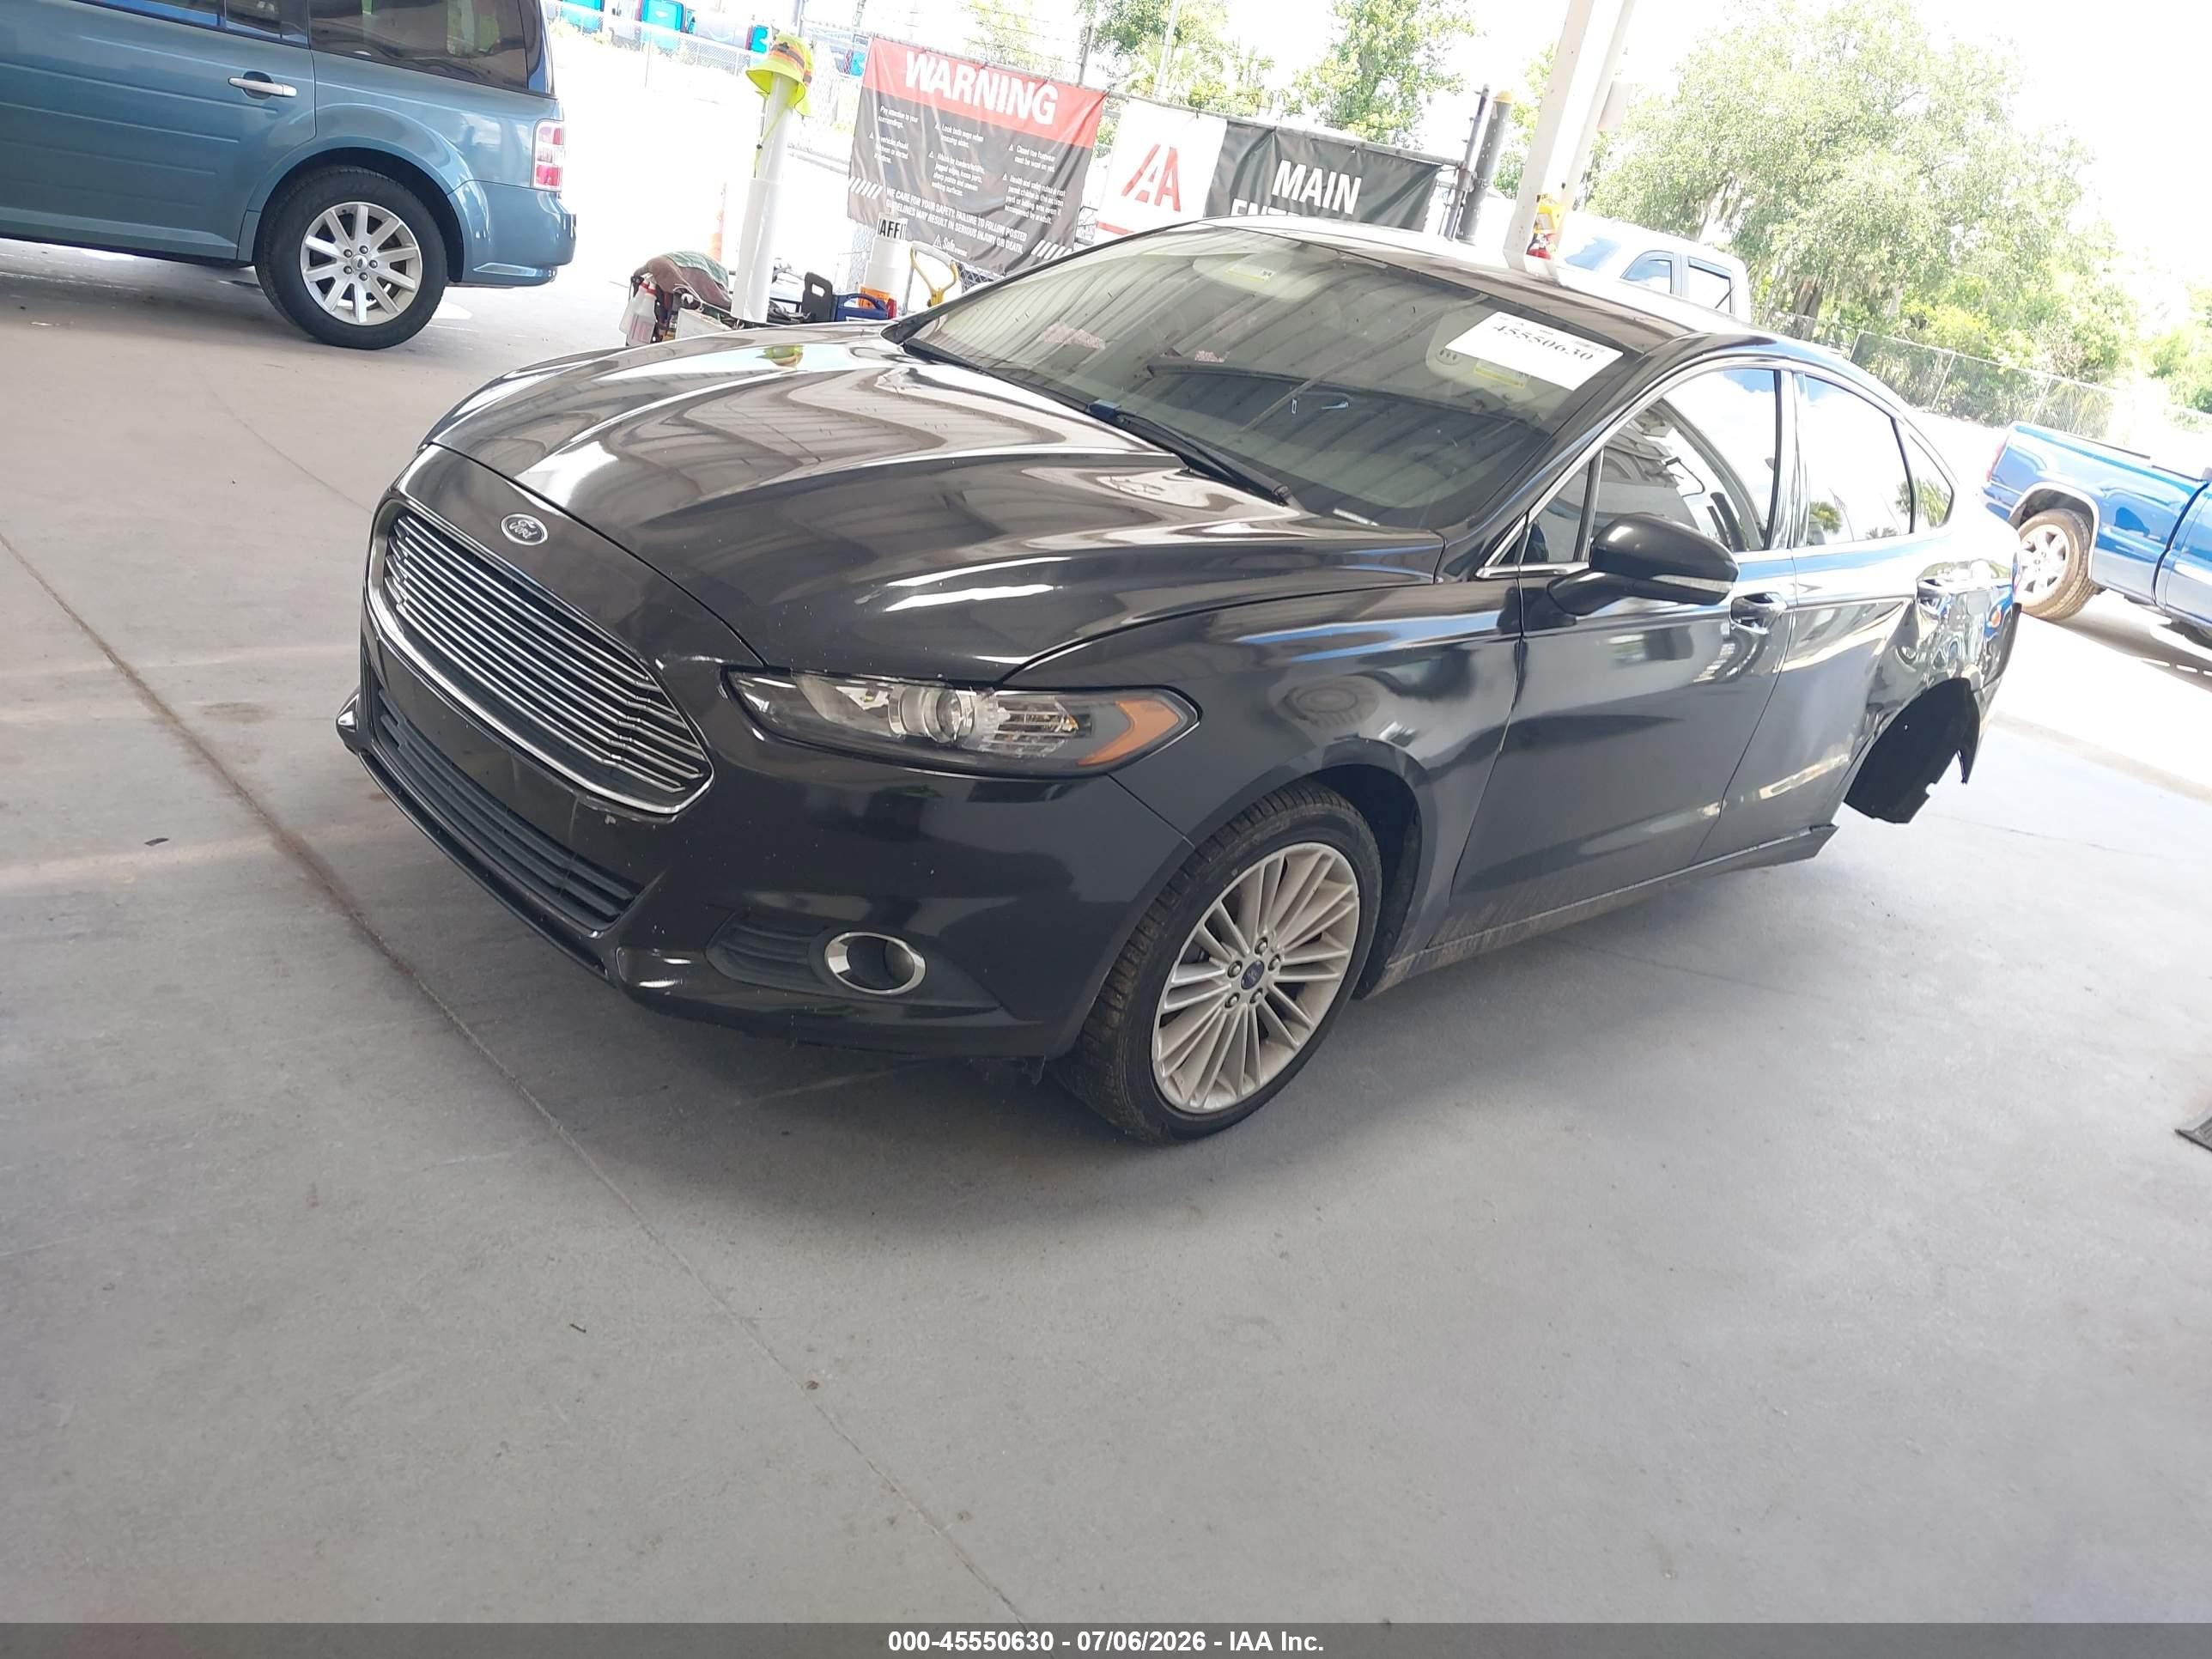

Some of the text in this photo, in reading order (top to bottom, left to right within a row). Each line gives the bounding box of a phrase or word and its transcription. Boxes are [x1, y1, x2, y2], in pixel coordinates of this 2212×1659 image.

[906, 52, 1058, 125] WARNING
[1271, 160, 1362, 214] MAIN
[886, 199, 915, 216] GUIDELINES
[916, 210, 928, 220] MAY
[927, 214, 948, 227] RESULT
[948, 220, 955, 230] IN
[955, 222, 977, 238] SERIOUS
[977, 230, 996, 245] INJURY
[997, 237, 1006, 247] OR
[887, 186, 896, 198] WE
[896, 191, 909, 203] CARE
[910, 194, 921, 206] FOR
[921, 198, 935, 211] YOUR
[956, 210, 977, 225] FAILURE
[978, 217, 985, 228] TO
[985, 220, 1006, 235] FOLLOW
[1006, 227, 1027, 242] POSTED
[1493, 325, 1594, 361] 45550630
[509, 519, 538, 539] Ford
